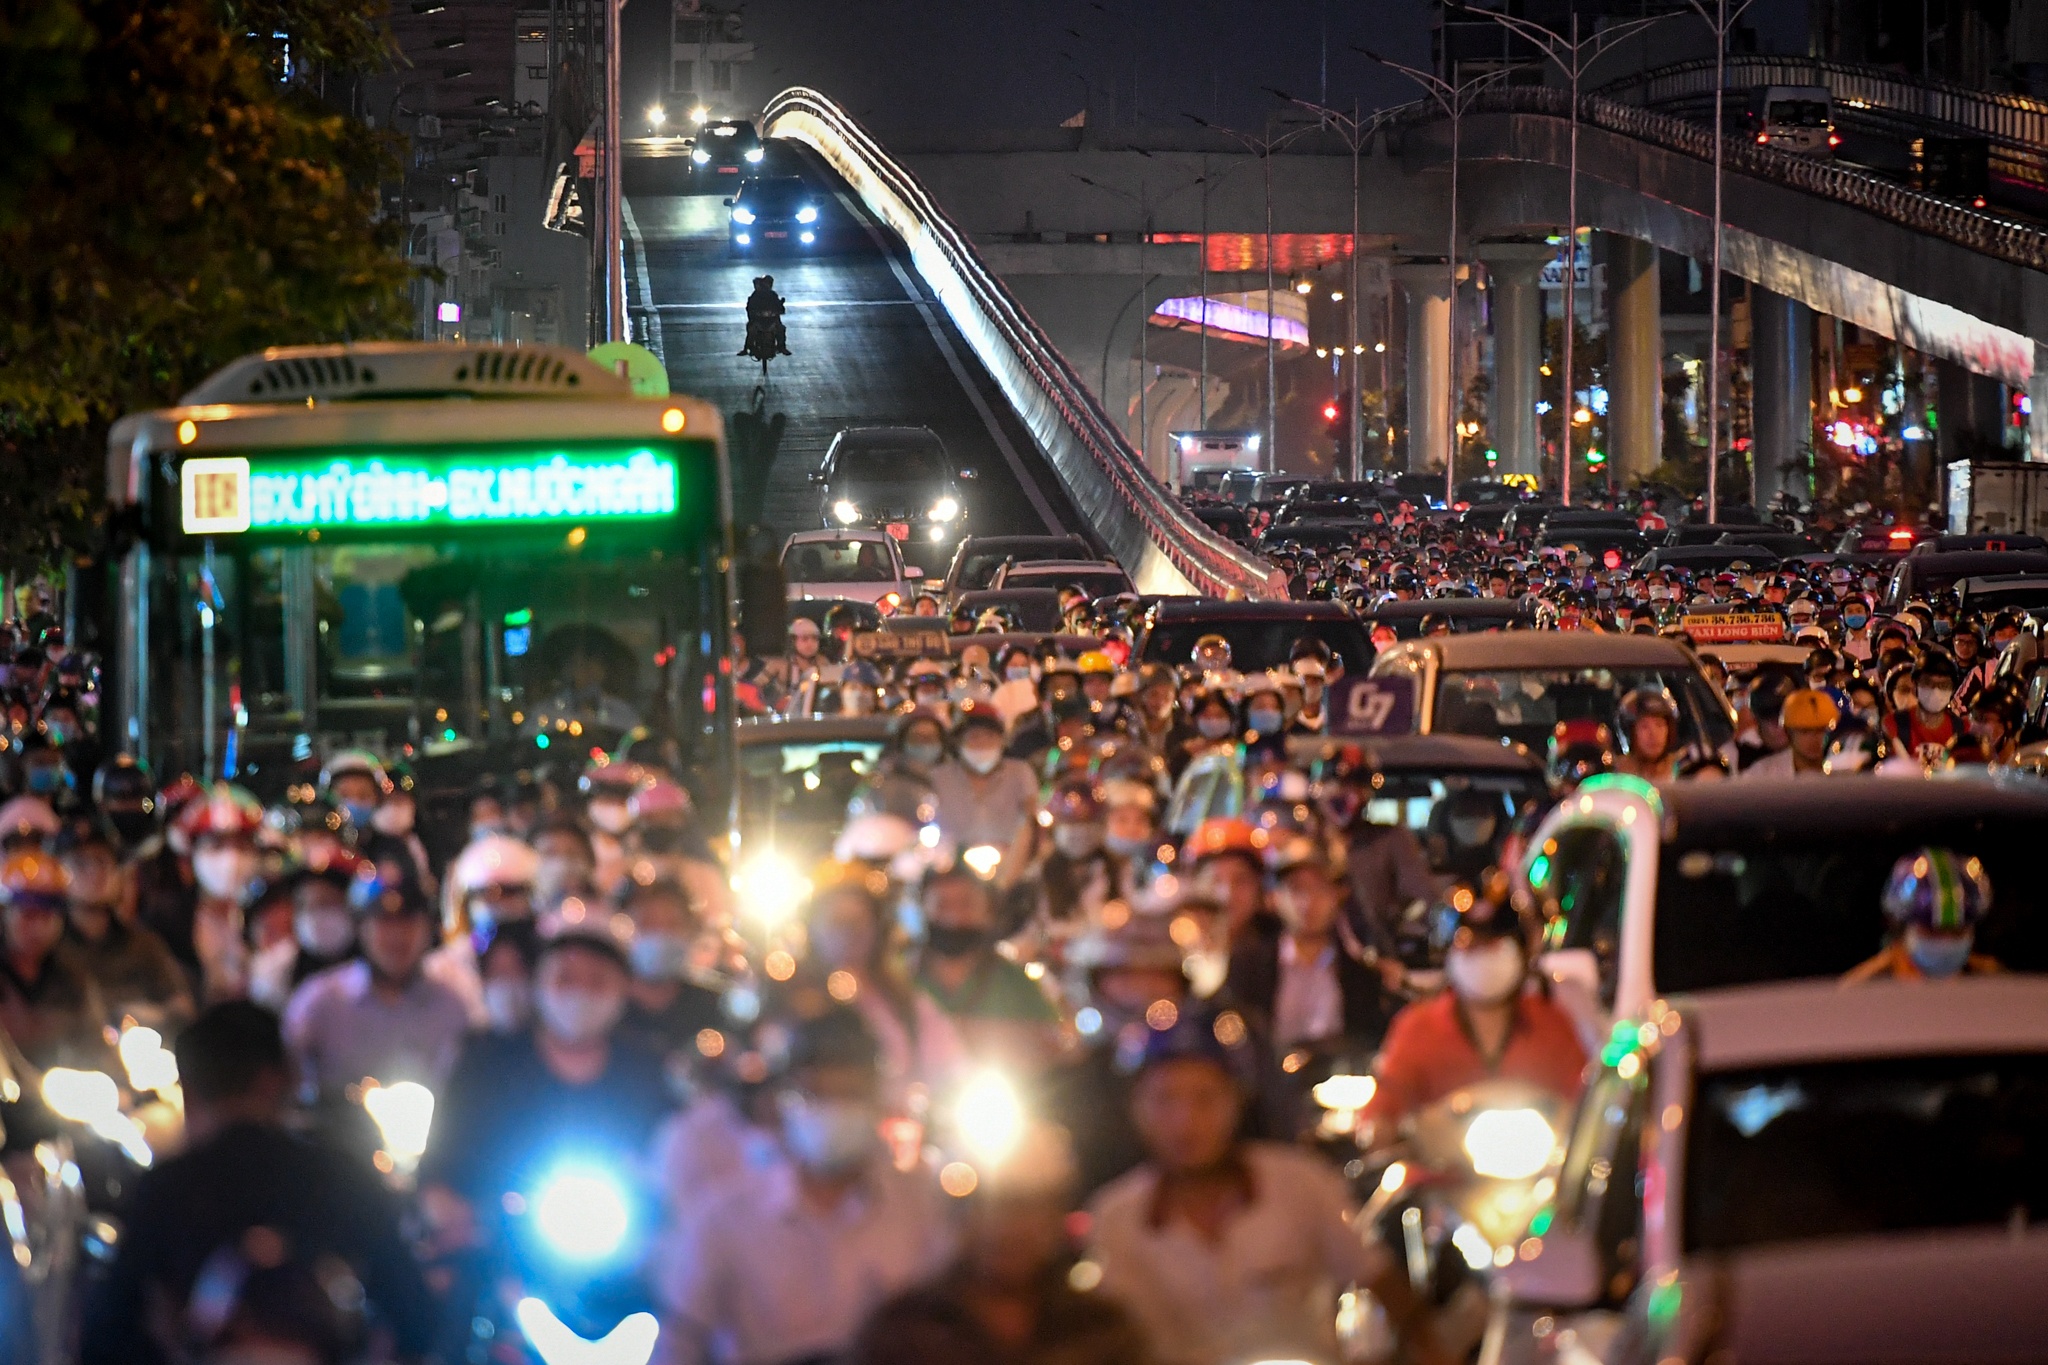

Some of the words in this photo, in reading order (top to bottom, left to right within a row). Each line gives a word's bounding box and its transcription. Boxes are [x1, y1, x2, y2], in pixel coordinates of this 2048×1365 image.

[1688, 627, 1714, 637] TAXI
[1717, 626, 1748, 637] LONG
[1751, 624, 1778, 636] BIÊN
